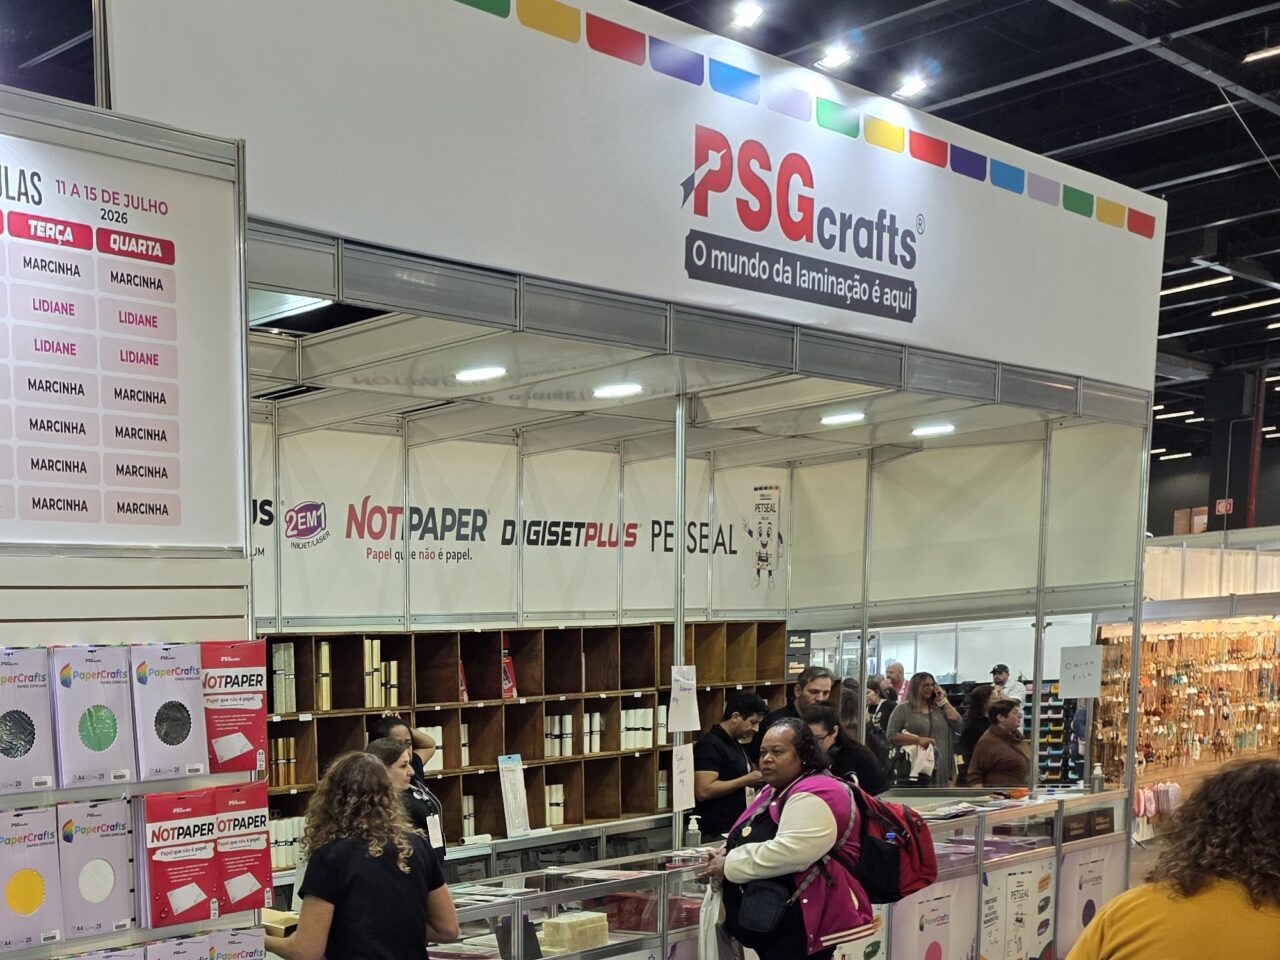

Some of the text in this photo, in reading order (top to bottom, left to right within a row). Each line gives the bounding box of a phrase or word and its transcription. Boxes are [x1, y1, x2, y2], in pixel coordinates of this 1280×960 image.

[56, 180, 168, 215] 11 A 15 DE JULHO
[680, 124, 917, 270] PSGcrafts
[100, 209, 128, 225] 2026
[28, 219, 73, 245] TERÇA
[110, 234, 162, 257] QUARTA
[23, 256, 81, 277] MARCINHA
[110, 271, 163, 291] MARCINHA
[693, 241, 912, 313] O mundo da laminação é aqui
[33, 299, 75, 316] LIDIANE
[119, 311, 157, 328] LIDIANE
[34, 339, 76, 356] LIDIANE
[120, 350, 159, 366] LIDIANE
[28, 378, 85, 396] MARCINHA
[114, 388, 166, 405] MARCINHA
[30, 419, 86, 435] MARCINHA
[115, 426, 167, 442] MARCINHA
[31, 458, 87, 474] MARCINHA
[116, 464, 168, 479] MARCINHA
[32, 497, 88, 512] MARCINHA
[117, 502, 168, 516] MARCINHA
[285, 502, 326, 538] 2EM1
[345, 495, 487, 542] NOTPAPER
[651, 520, 737, 554] PESEAL
[367, 548, 391, 563] Papel
[419, 549, 435, 560] não
[438, 549, 443, 560] é
[446, 548, 472, 563] papel.
[73, 668, 128, 680] PaperCrafts
[149, 666, 200, 677] PaperCrafts
[75, 822, 125, 834] PaperCrafts
[216, 815, 266, 832] OTPAPER
[151, 823, 214, 843] NOTPAPER
[216, 949, 263, 960] PaperCrafts
